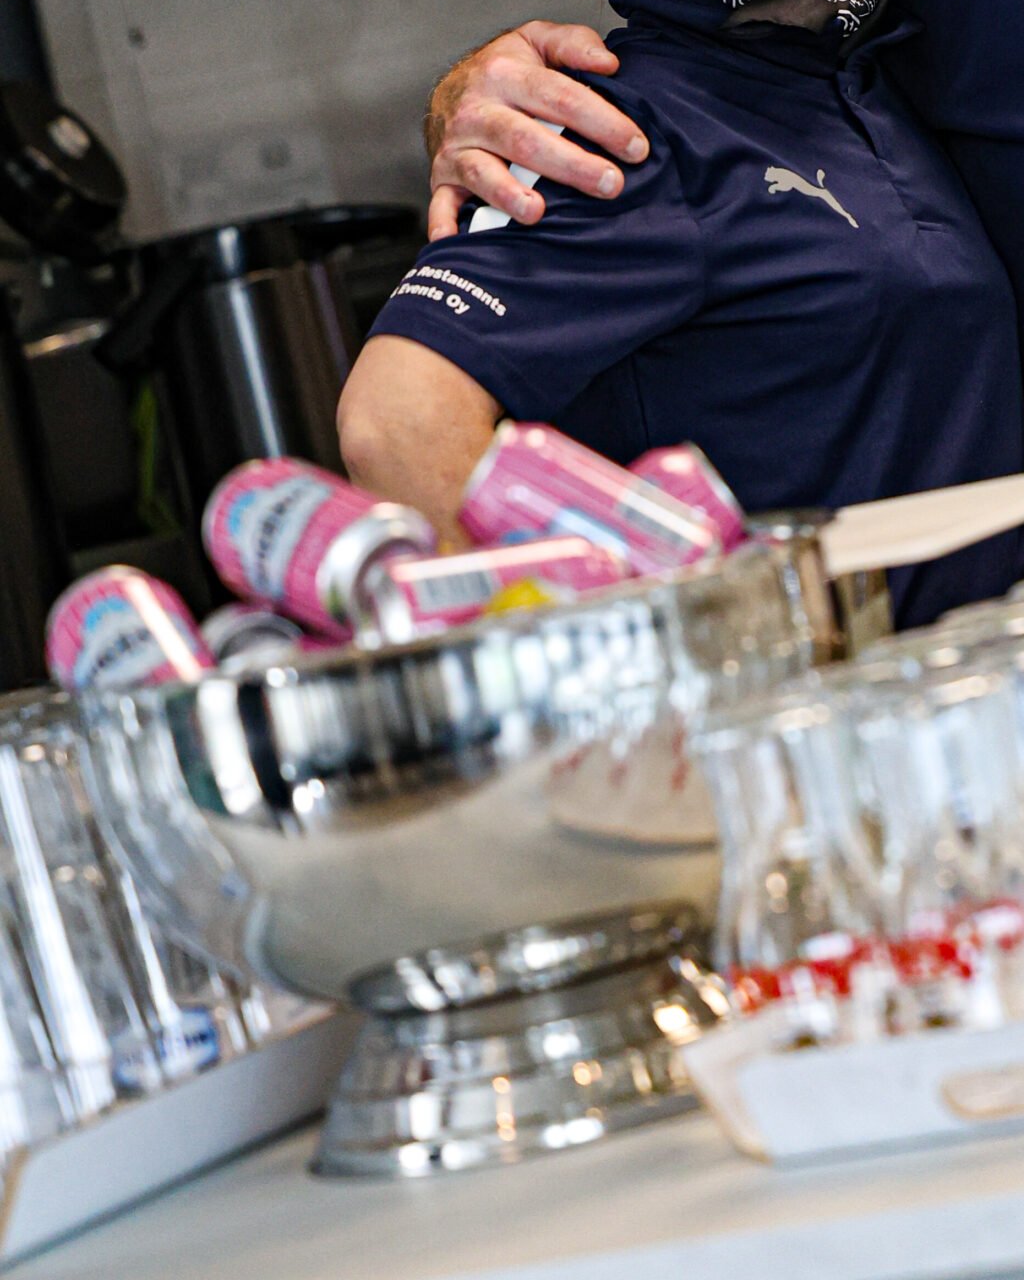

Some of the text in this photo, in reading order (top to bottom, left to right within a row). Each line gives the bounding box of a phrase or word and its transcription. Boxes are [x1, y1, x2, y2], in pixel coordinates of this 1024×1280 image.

[397, 282, 445, 301] Events
[445, 293, 471, 315] Oy
[416, 265, 507, 317] Restaurants
